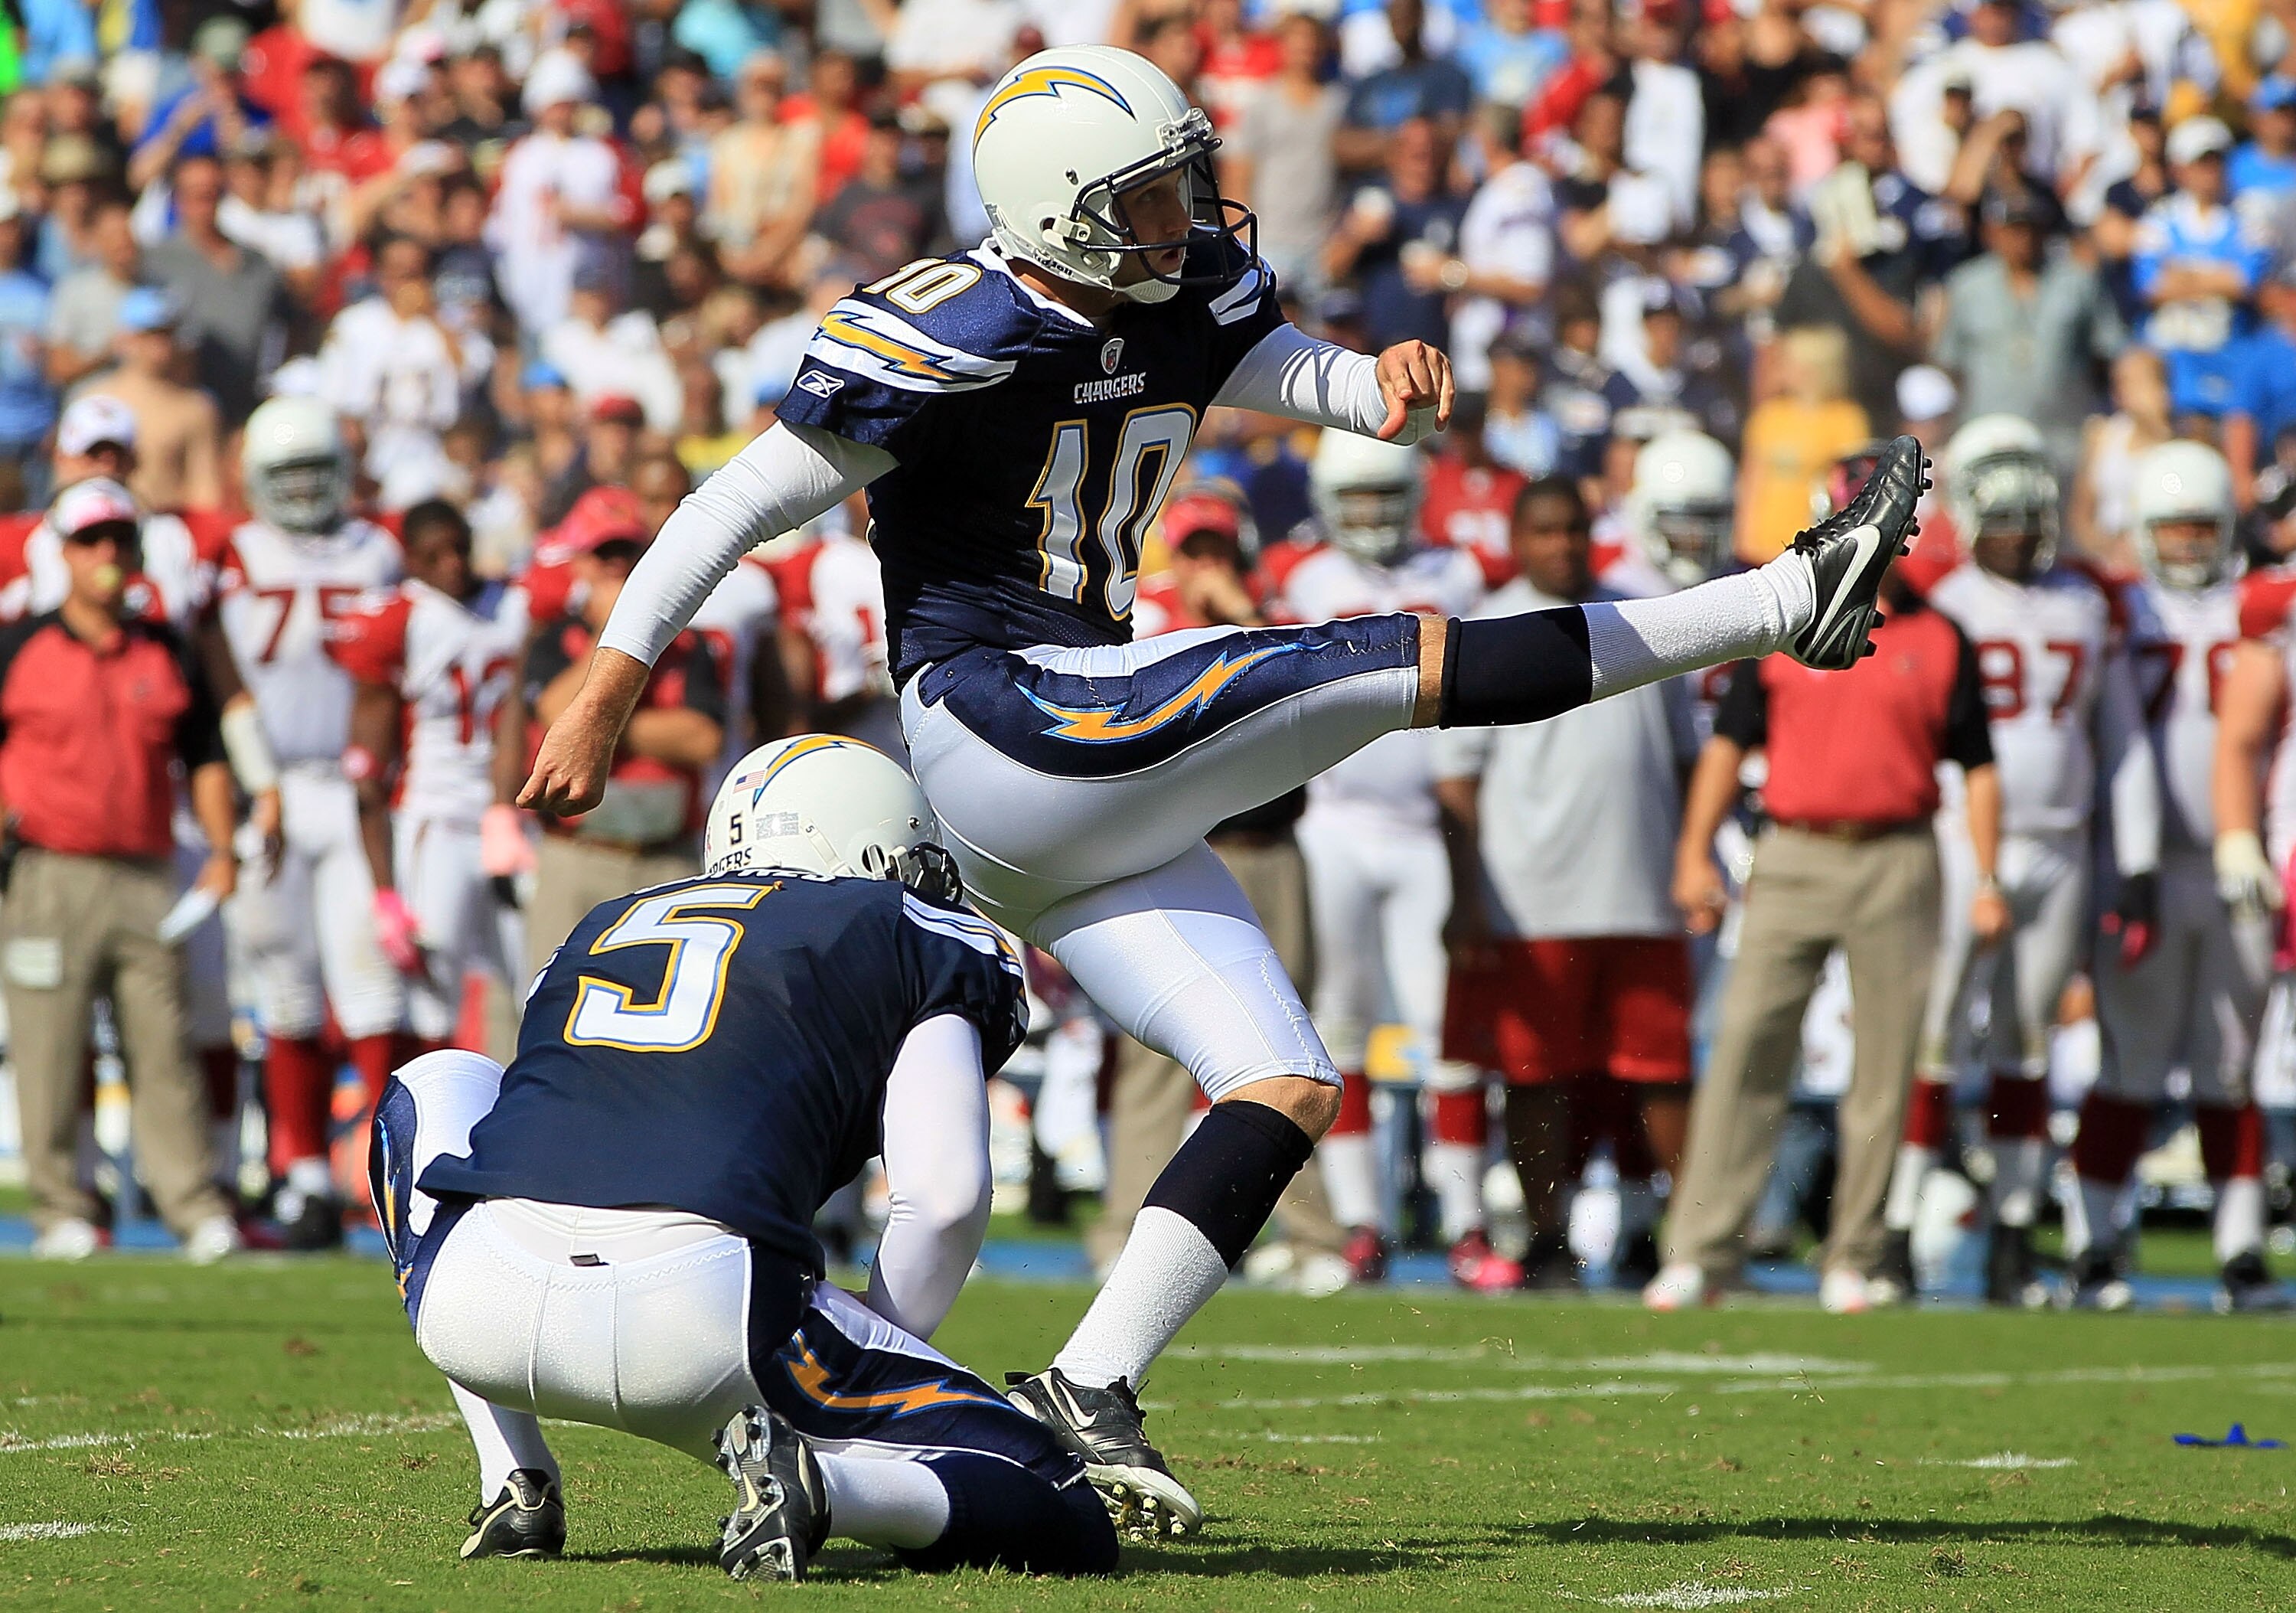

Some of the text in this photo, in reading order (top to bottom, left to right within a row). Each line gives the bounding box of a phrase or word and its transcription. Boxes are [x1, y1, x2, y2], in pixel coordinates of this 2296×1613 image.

[862, 257, 983, 315] 10
[1074, 371, 1146, 404] CHARGERS
[1025, 401, 1198, 622] 10
[729, 813, 742, 846] 5
[805, 824, 815, 834] 5
[563, 882, 775, 1053] 5
